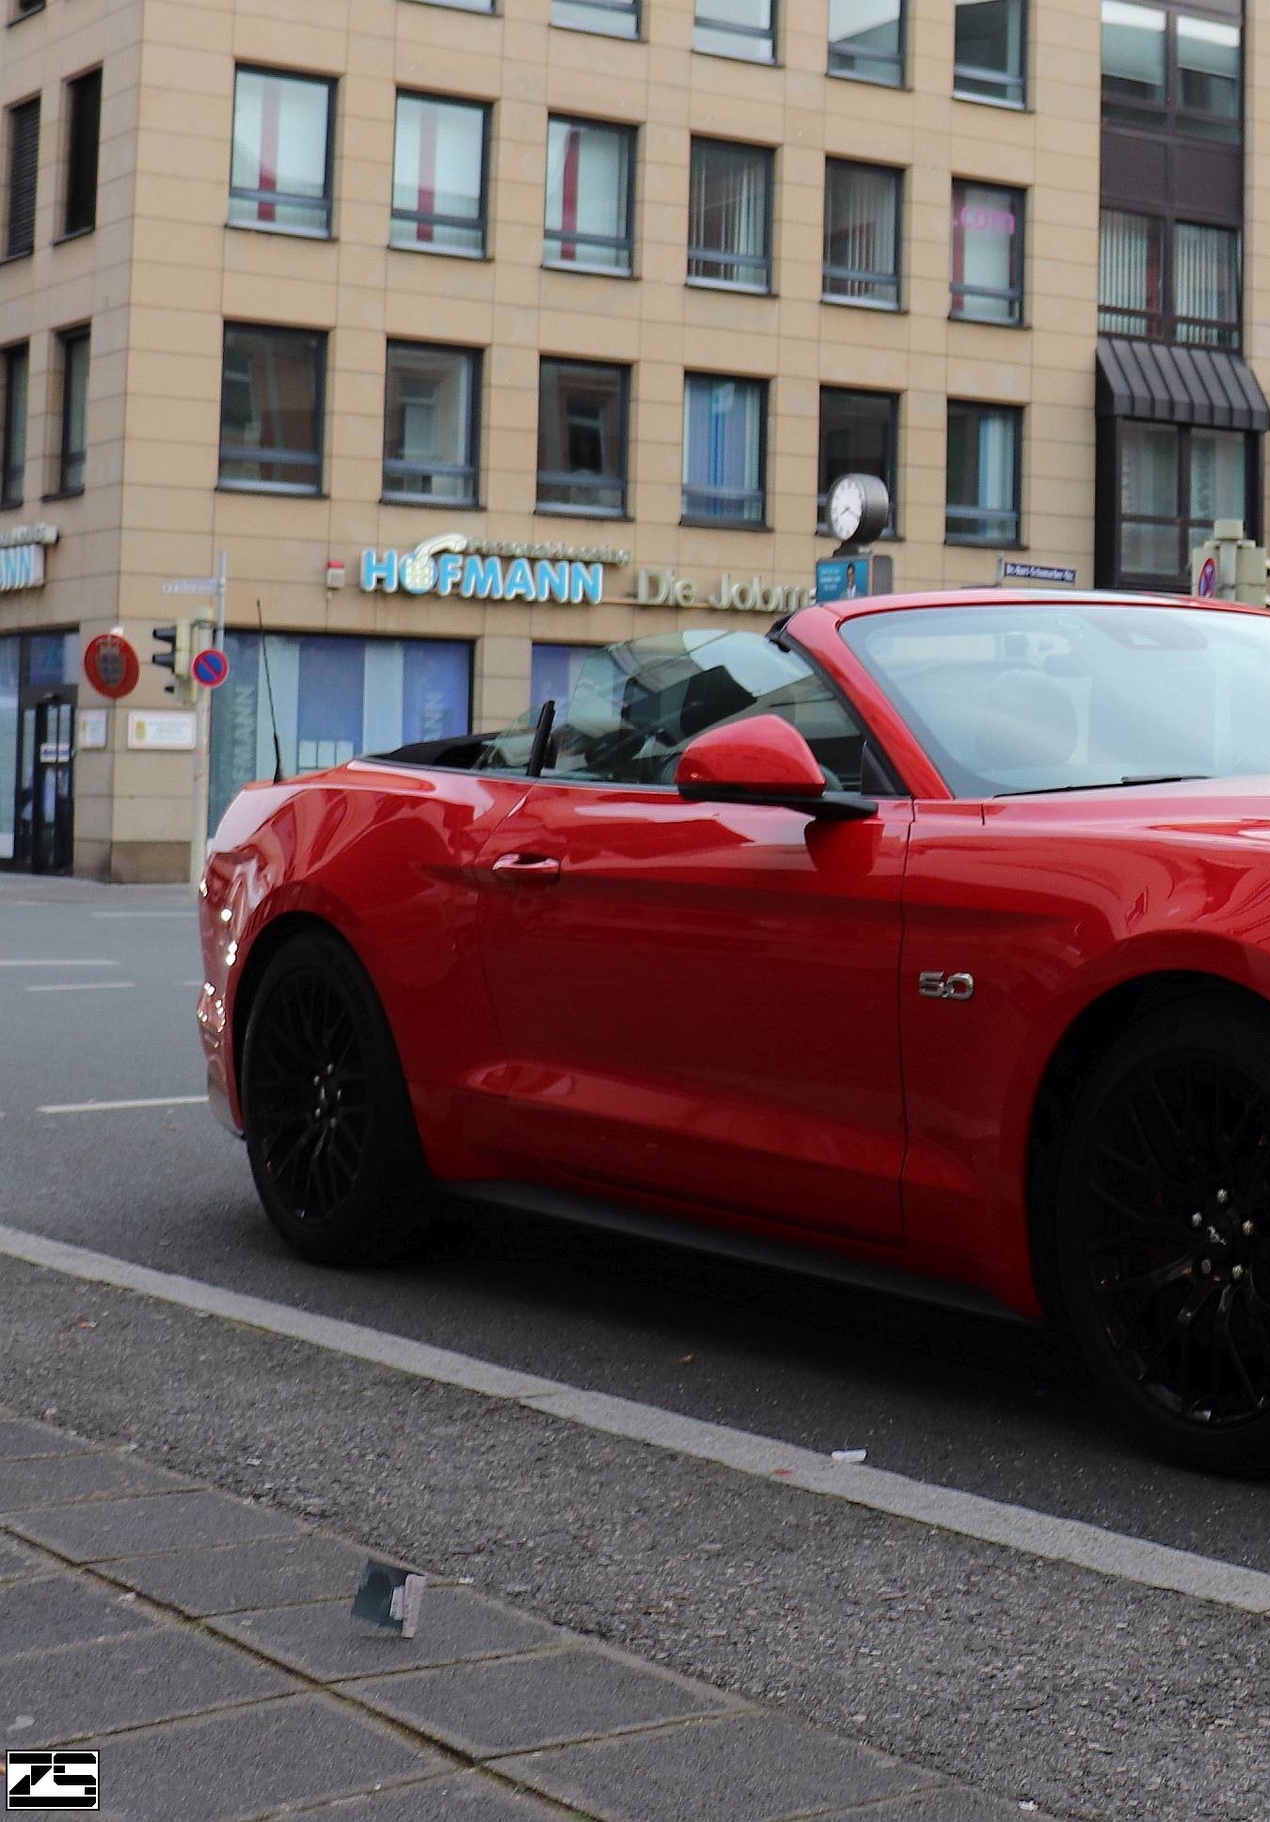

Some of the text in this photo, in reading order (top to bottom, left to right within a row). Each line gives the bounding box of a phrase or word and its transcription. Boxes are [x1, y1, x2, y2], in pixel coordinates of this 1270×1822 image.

[361, 548, 603, 604] HOFMANN
[637, 568, 697, 608] Die
[919, 971, 974, 1000] 5.0
